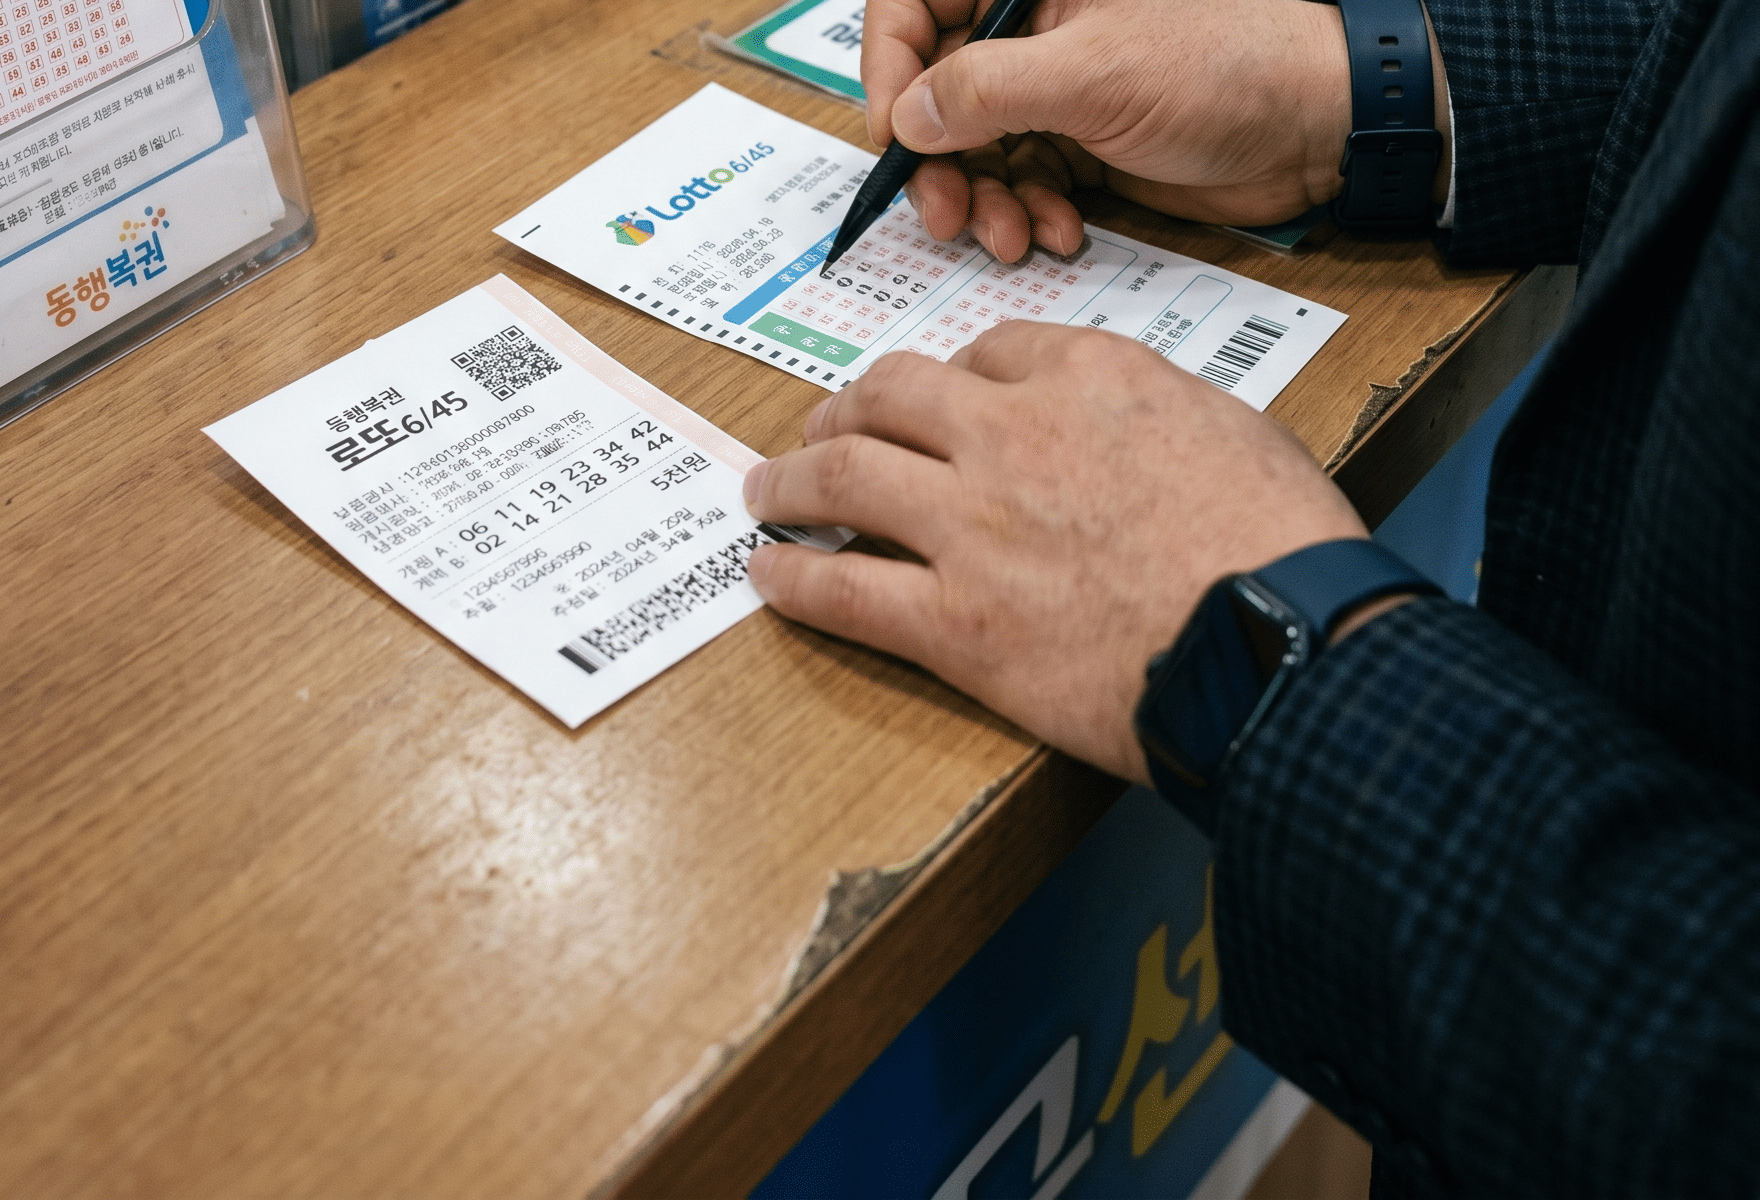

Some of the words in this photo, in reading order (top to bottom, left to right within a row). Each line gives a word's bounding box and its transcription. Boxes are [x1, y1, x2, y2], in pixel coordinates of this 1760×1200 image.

[46, 230, 167, 327] 동행복권
[325, 391, 468, 471] 로또6/45
[650, 452, 711, 491] 5천원
[459, 522, 488, 542] 06
[494, 502, 521, 519] 11
[530, 481, 556, 499] 19
[560, 460, 591, 481] 23
[593, 441, 623, 461] 34
[631, 420, 658, 440] 42
[475, 535, 506, 554] 02
[512, 514, 540, 532] 14
[543, 494, 572, 513] 21
[576, 473, 607, 493] 28
[610, 453, 640, 473] 35
[648, 433, 673, 451] 44
